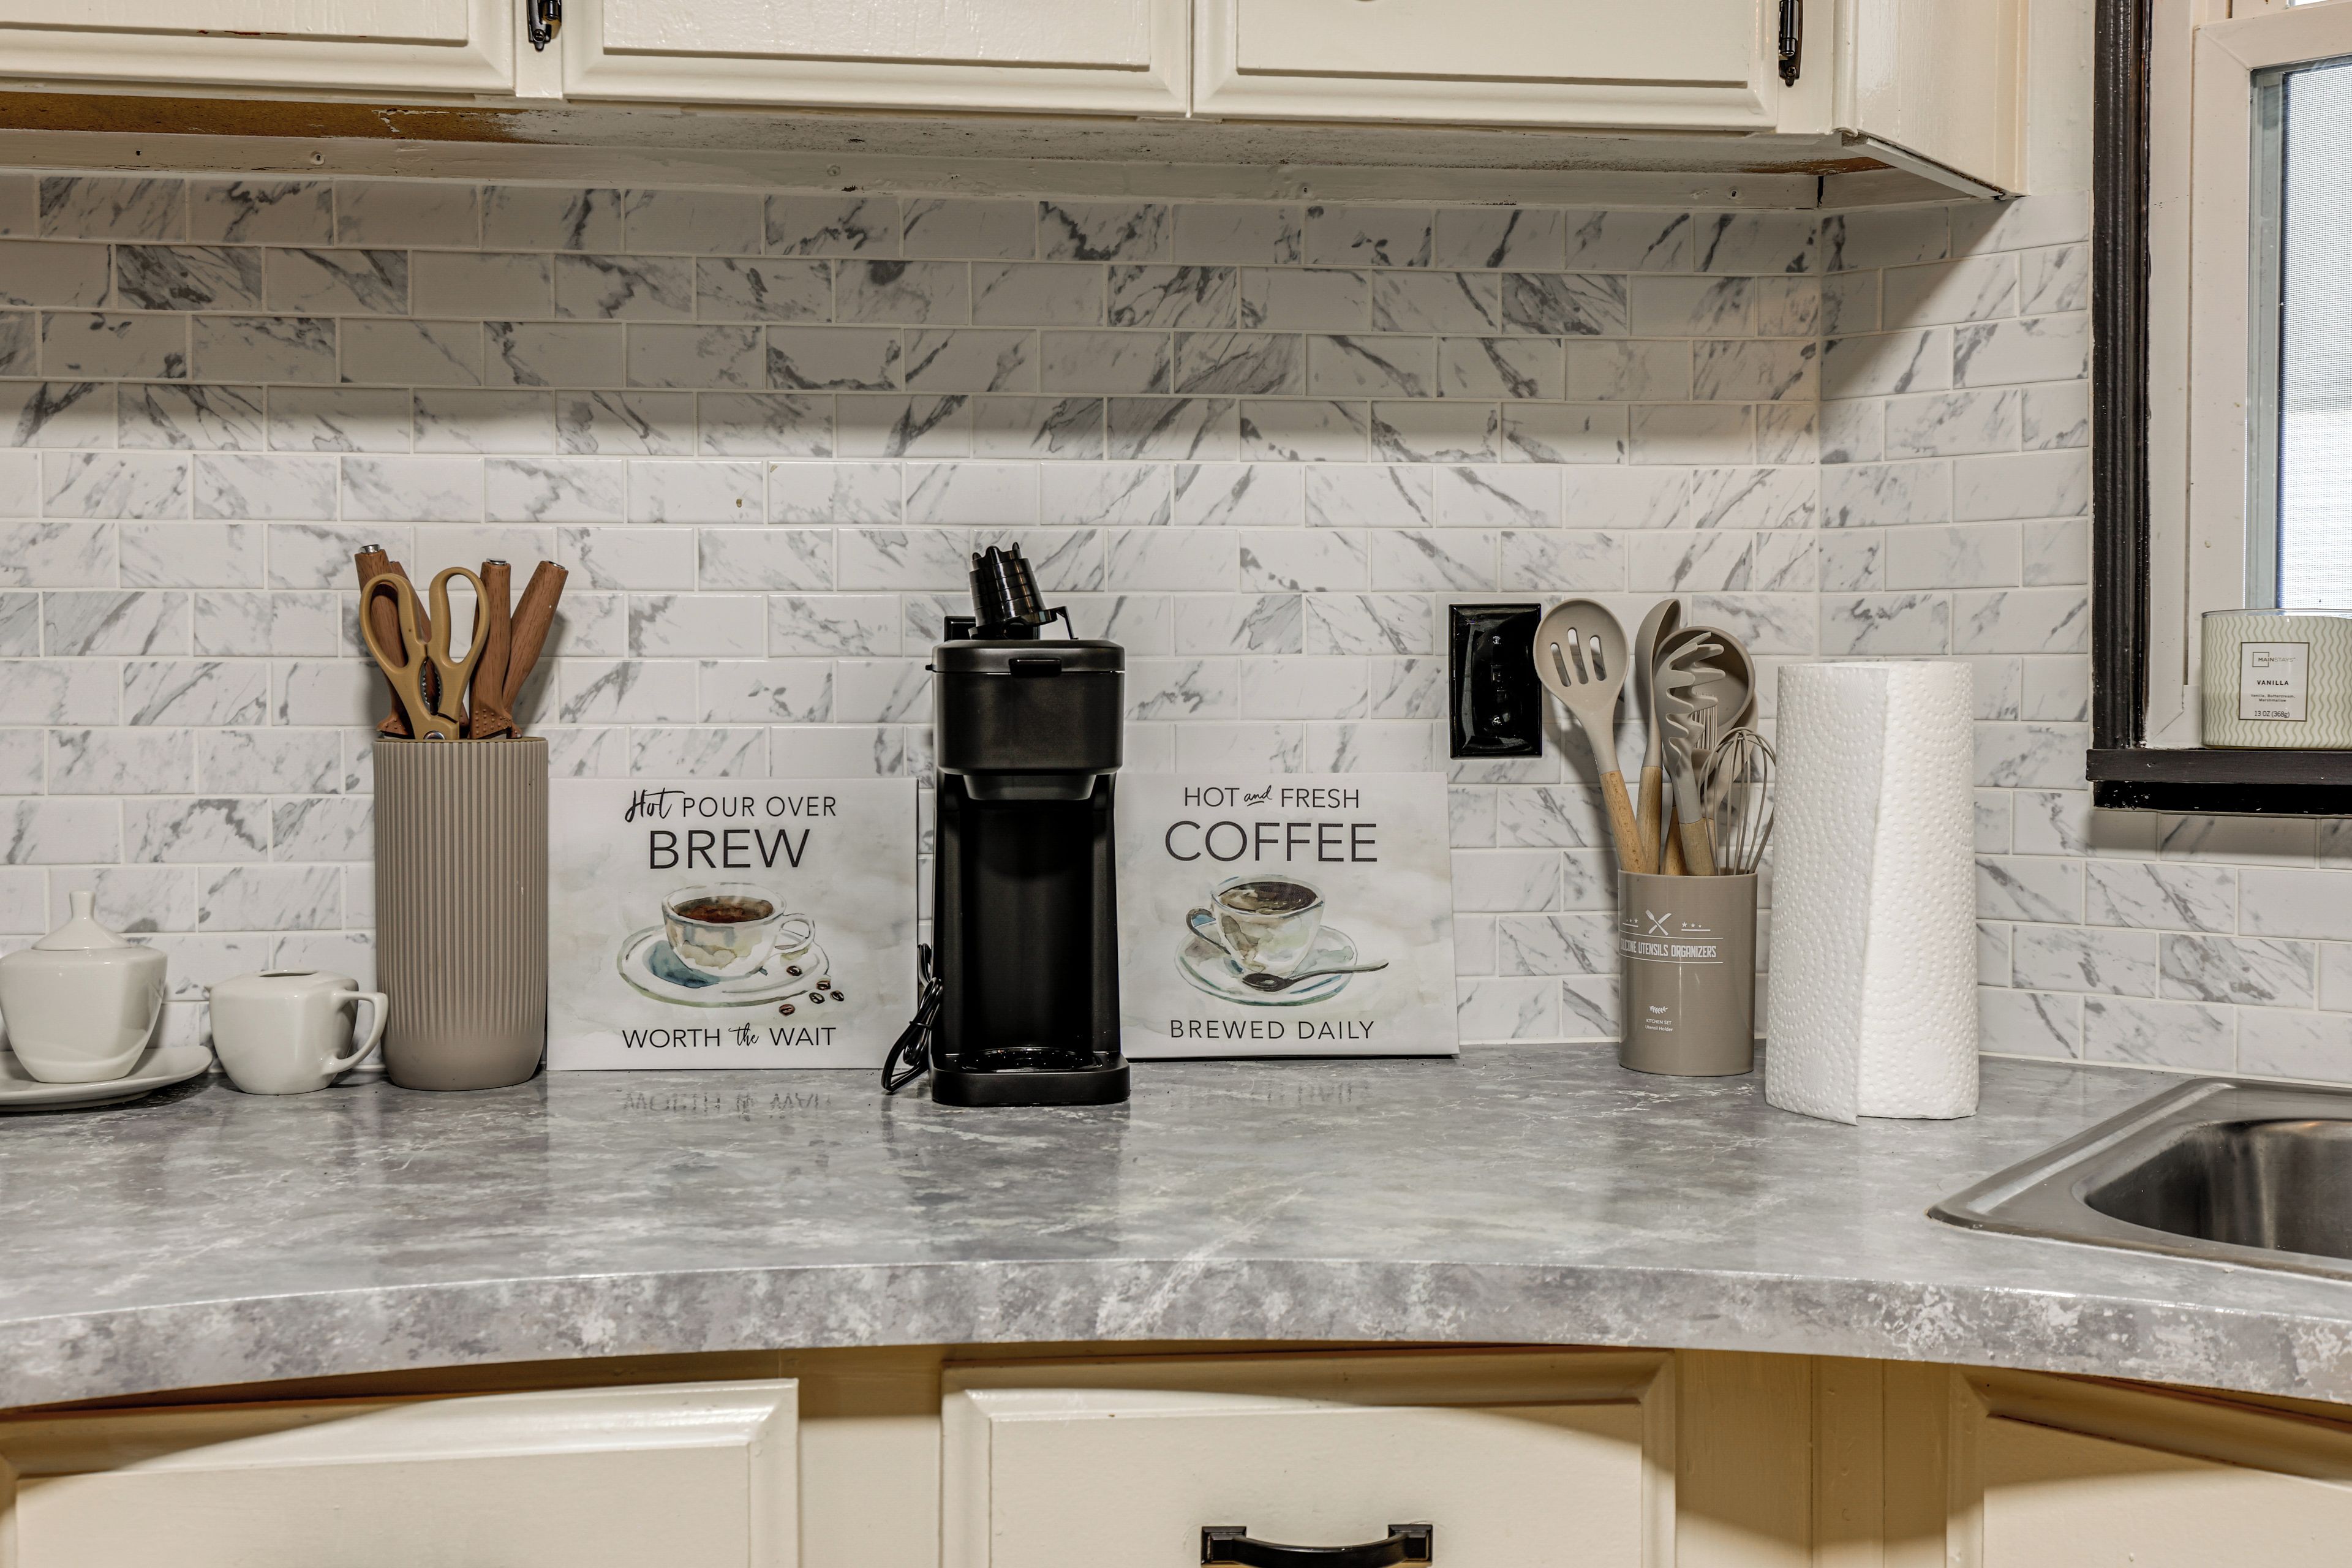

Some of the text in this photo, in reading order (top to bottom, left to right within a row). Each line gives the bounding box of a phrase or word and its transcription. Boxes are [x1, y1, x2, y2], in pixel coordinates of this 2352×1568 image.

[625, 788, 837, 823] Hot POUR OVER
[1185, 785, 1359, 809] HOT and FRESH
[650, 829, 810, 870] BREW
[1165, 820, 1378, 862] COFFEE
[1638, 942, 1668, 957] UTENSILS
[1671, 945, 1716, 958] ORGANIZERS
[622, 1022, 837, 1048] WORTH the WAIT
[1170, 1020, 1374, 1039] BREWED DAILY
